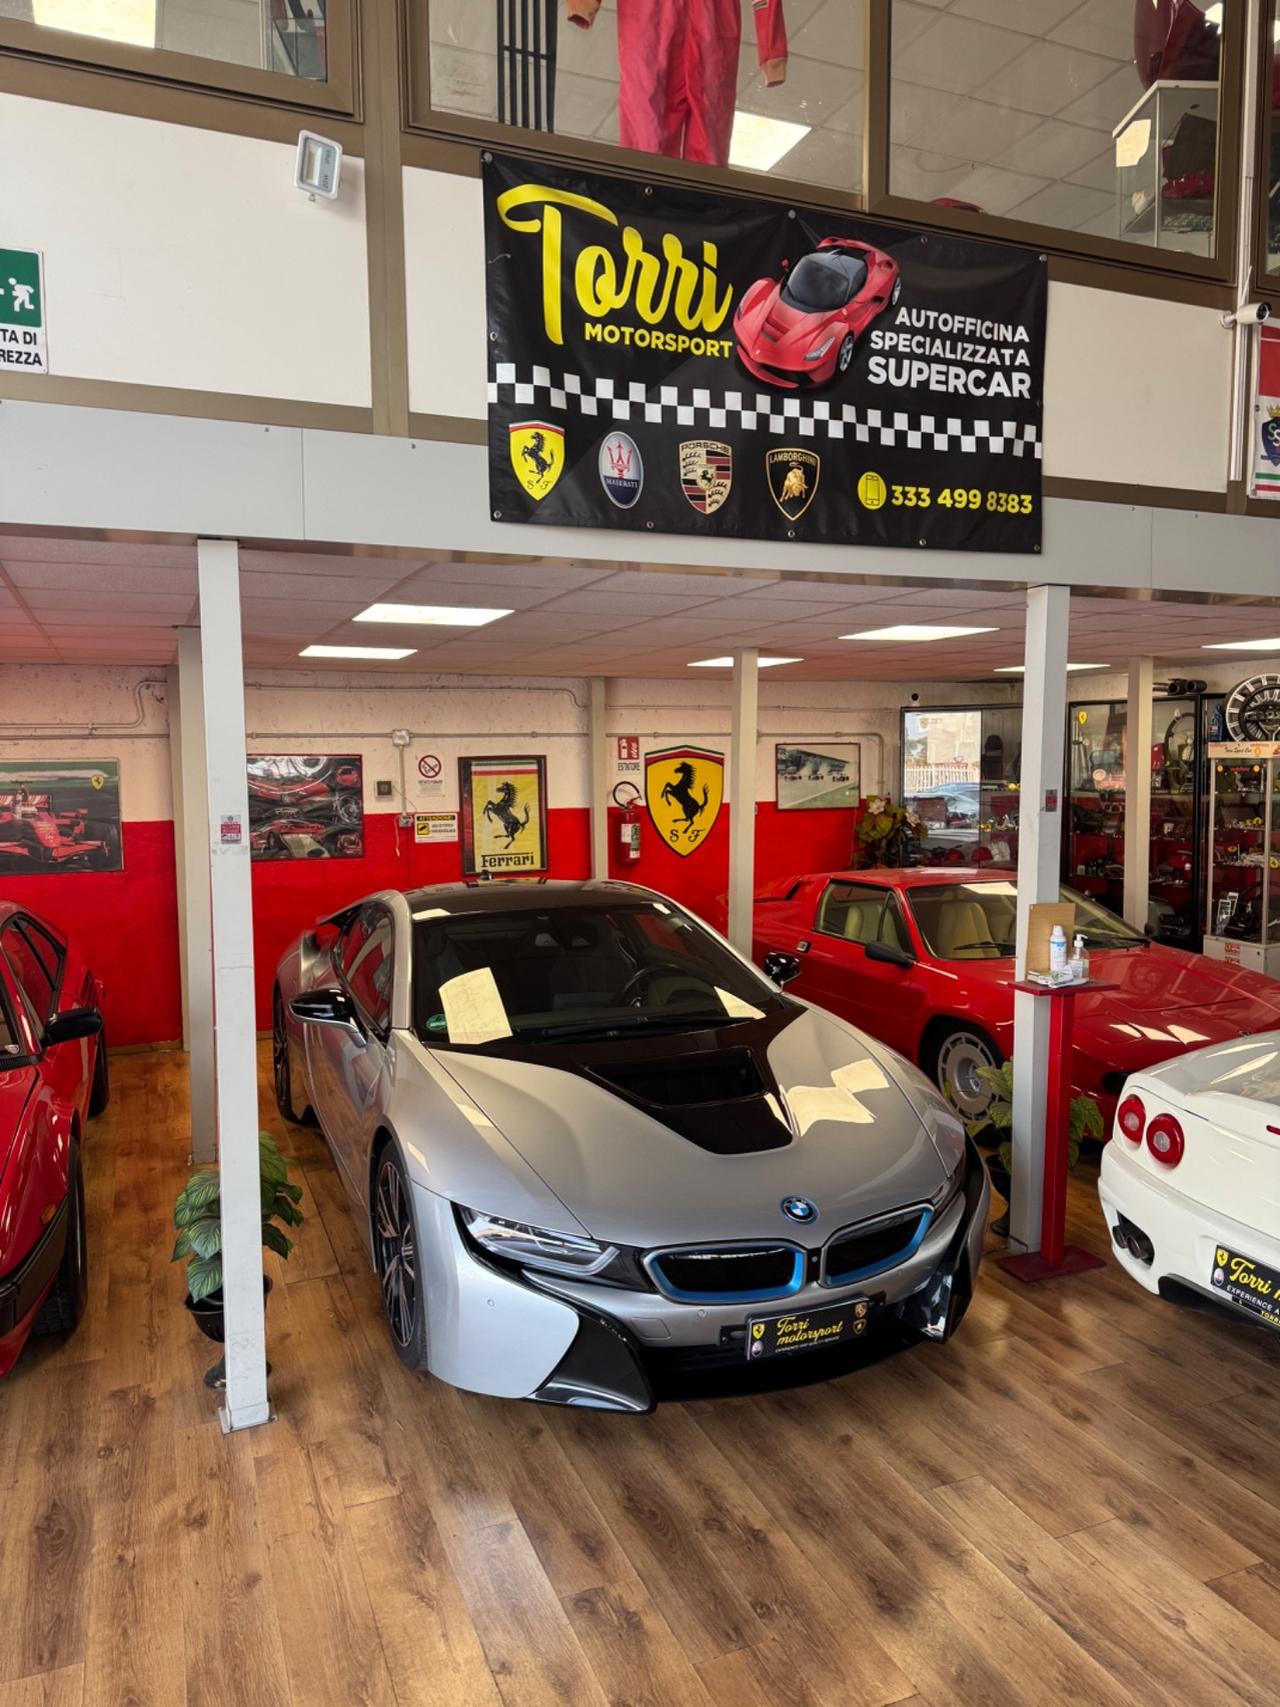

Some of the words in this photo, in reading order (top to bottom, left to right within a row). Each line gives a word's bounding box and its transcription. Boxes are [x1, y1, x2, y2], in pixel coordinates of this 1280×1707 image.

[497, 183, 733, 345] Torri
[894, 306, 1030, 343] AUTOFFICINA
[23, 331, 37, 346] DI
[584, 322, 733, 358] MOTORSPORT
[870, 330, 1031, 367] SPECIALIZZATA
[867, 355, 1032, 399] SUPERCAR
[680, 441, 730, 454] PORSCHE
[769, 452, 817, 467] LAMBORGHINI
[604, 477, 639, 489] MASERATI
[891, 485, 931, 508] 333
[937, 488, 982, 510] 499
[986, 490, 1033, 514] 8383
[669, 829, 679, 843] S
[480, 852, 535, 868] Ferrari
[1229, 1257, 1272, 1294] Torri
[1226, 1284, 1273, 1312] EXPERIENCE
[776, 1315, 810, 1336] Torri
[776, 1321, 843, 1346] motorsport
